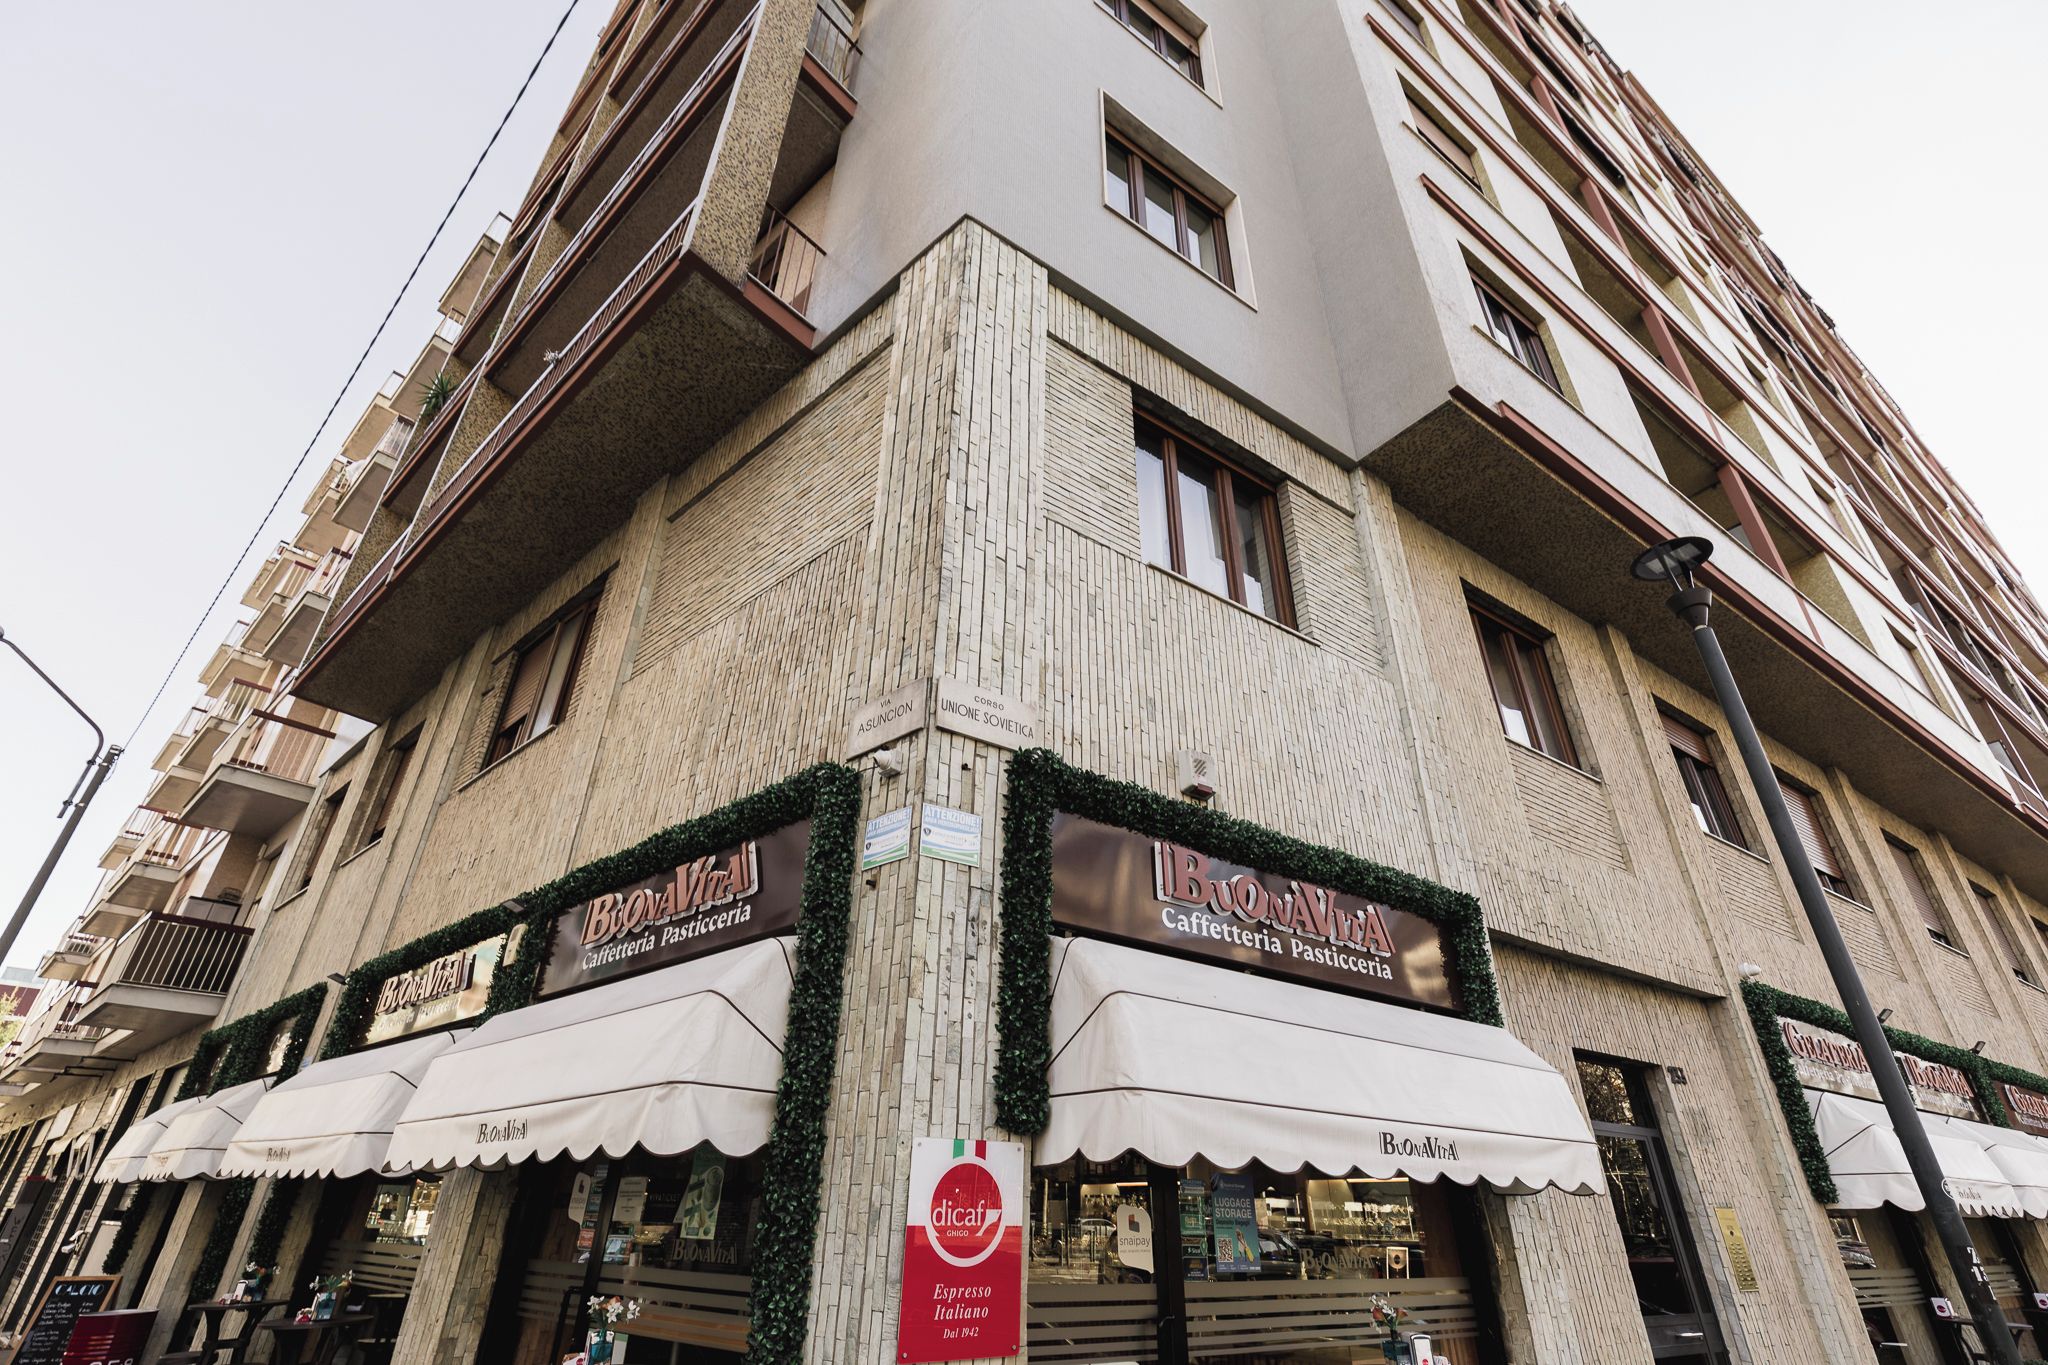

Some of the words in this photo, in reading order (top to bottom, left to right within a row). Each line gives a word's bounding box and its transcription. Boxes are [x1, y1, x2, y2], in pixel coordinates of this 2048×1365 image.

[880, 698, 891, 708] VIA
[974, 695, 1005, 711] CORSO
[857, 700, 913, 736] ASUNCION
[941, 698, 980, 722] UNIONE
[983, 711, 1034, 739] SOVIETICA
[867, 807, 911, 831] ATTENZIONE!
[924, 804, 980, 828] ATTENZIONE!
[581, 932, 655, 971] Caffetteria
[660, 901, 752, 947] Pasticceria
[1161, 907, 1284, 955] Caffetteria
[1291, 937, 1394, 981] Pasticceria
[1378, 1131, 1460, 1161] BUONAVITA
[1214, 1196, 1251, 1209] LUGGAGE
[1215, 1207, 1253, 1219] STORAGE
[946, 1229, 969, 1237] GHIGO
[1119, 1235, 1151, 1248] snaipay
[55, 1284, 104, 1296] CALCIO
[933, 1283, 992, 1302] Espresso
[933, 1303, 989, 1321] Italiano
[943, 1328, 960, 1339] Dal
[961, 1326, 980, 1338] 1942
